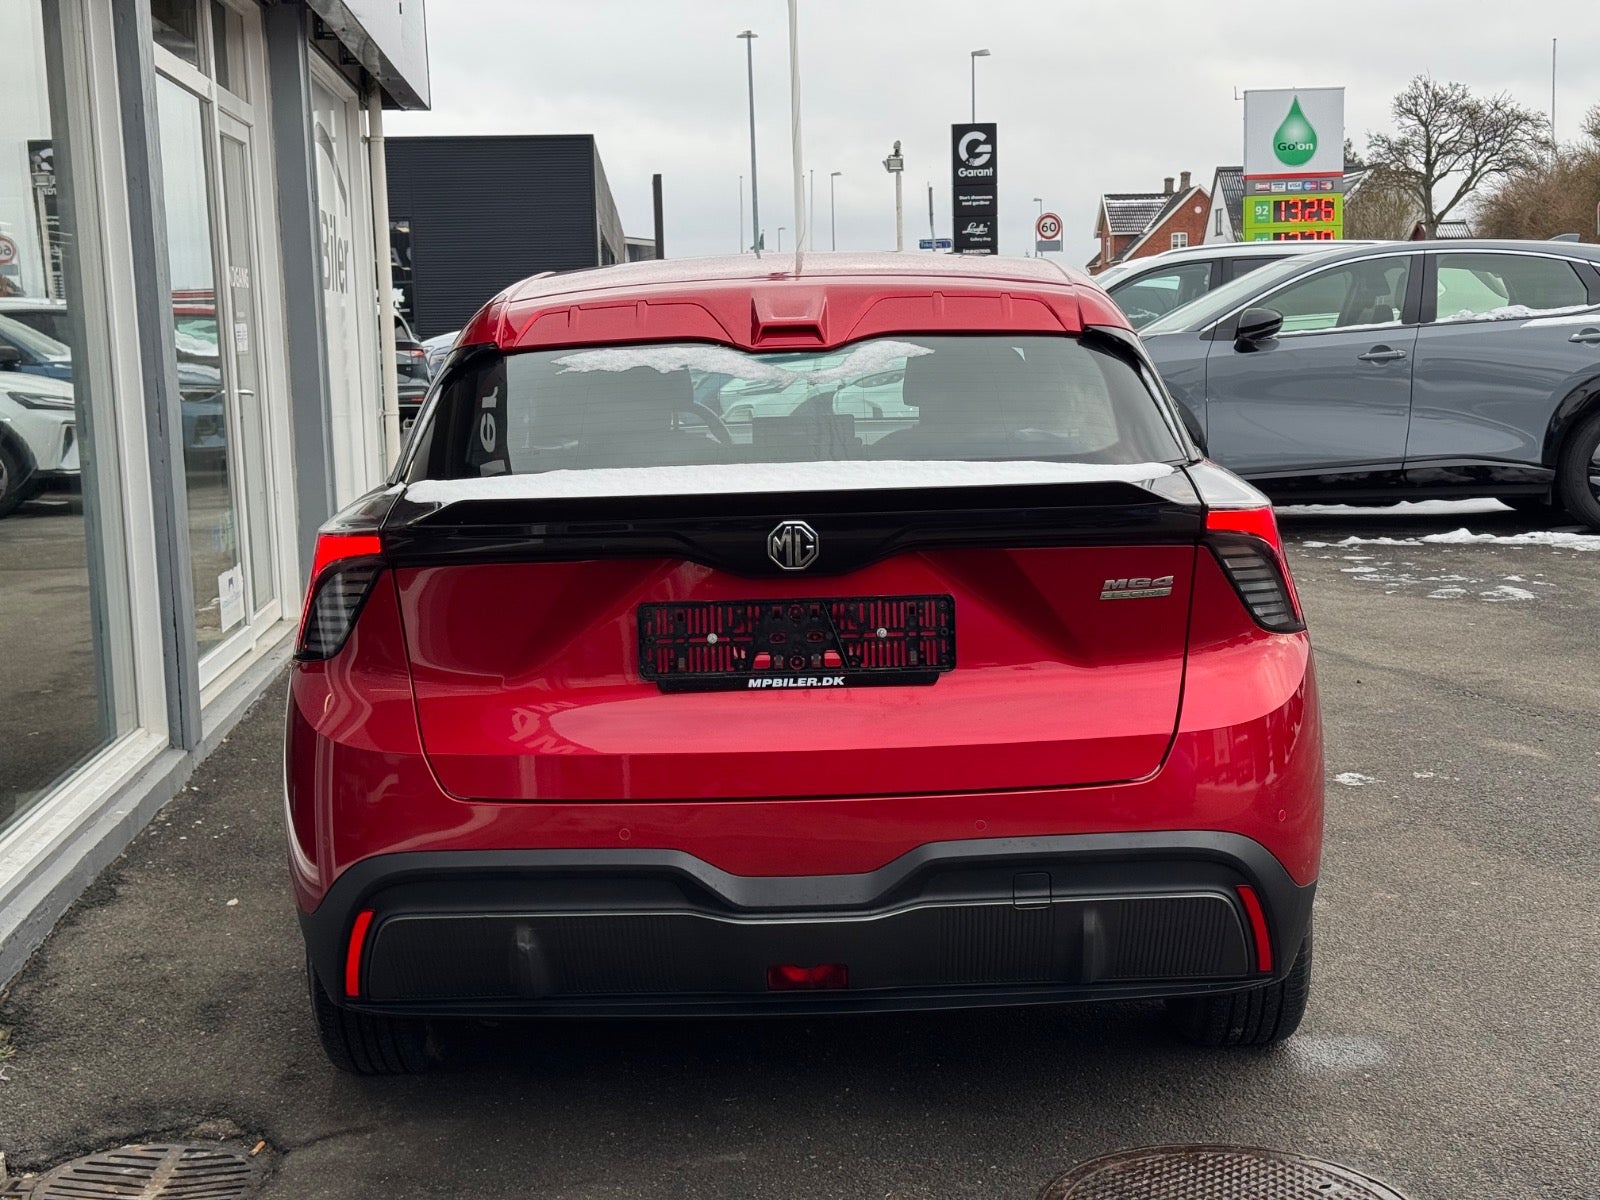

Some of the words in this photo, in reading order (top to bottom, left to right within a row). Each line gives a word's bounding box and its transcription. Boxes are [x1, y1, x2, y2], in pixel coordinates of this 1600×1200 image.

[958, 167, 993, 177] Garant
[1256, 206, 1269, 215] 92
[1281, 198, 1335, 222] 13.26
[1041, 222, 1057, 232] 60
[320, 210, 349, 294] Biler
[771, 524, 817, 568] MG
[1102, 575, 1174, 590] MG4
[748, 676, 846, 688] MPBILER.DK
